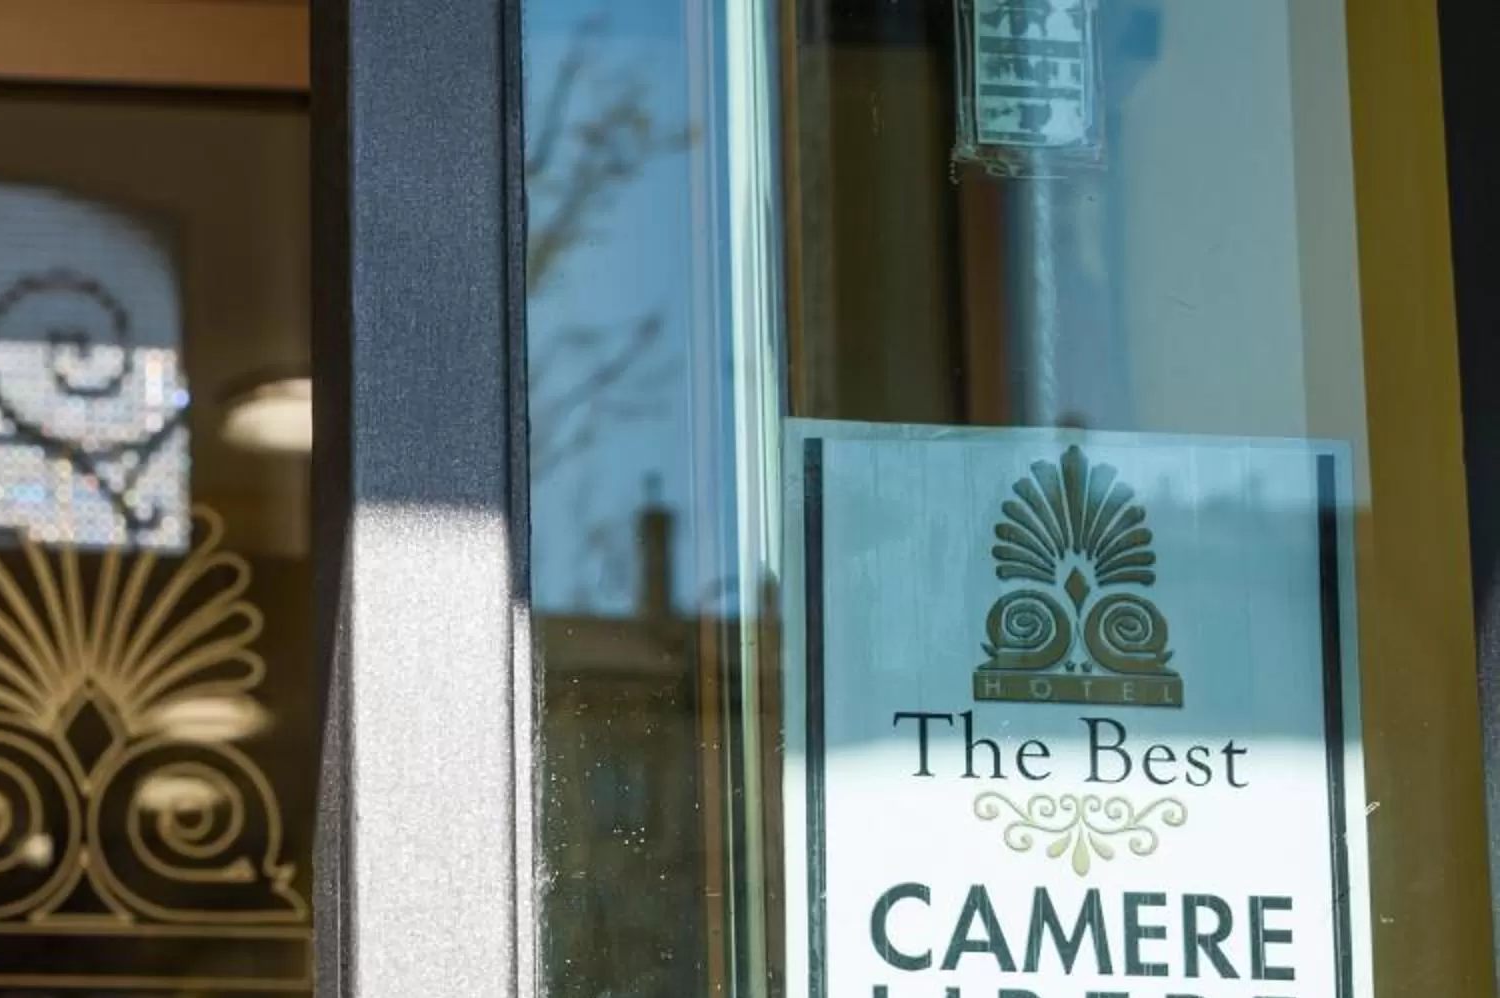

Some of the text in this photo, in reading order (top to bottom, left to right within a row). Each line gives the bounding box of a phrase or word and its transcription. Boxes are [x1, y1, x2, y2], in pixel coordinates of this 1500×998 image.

[984, 676, 1173, 704] HOTEL
[893, 710, 1250, 788] The Best
[870, 882, 1296, 981] CAMERE
